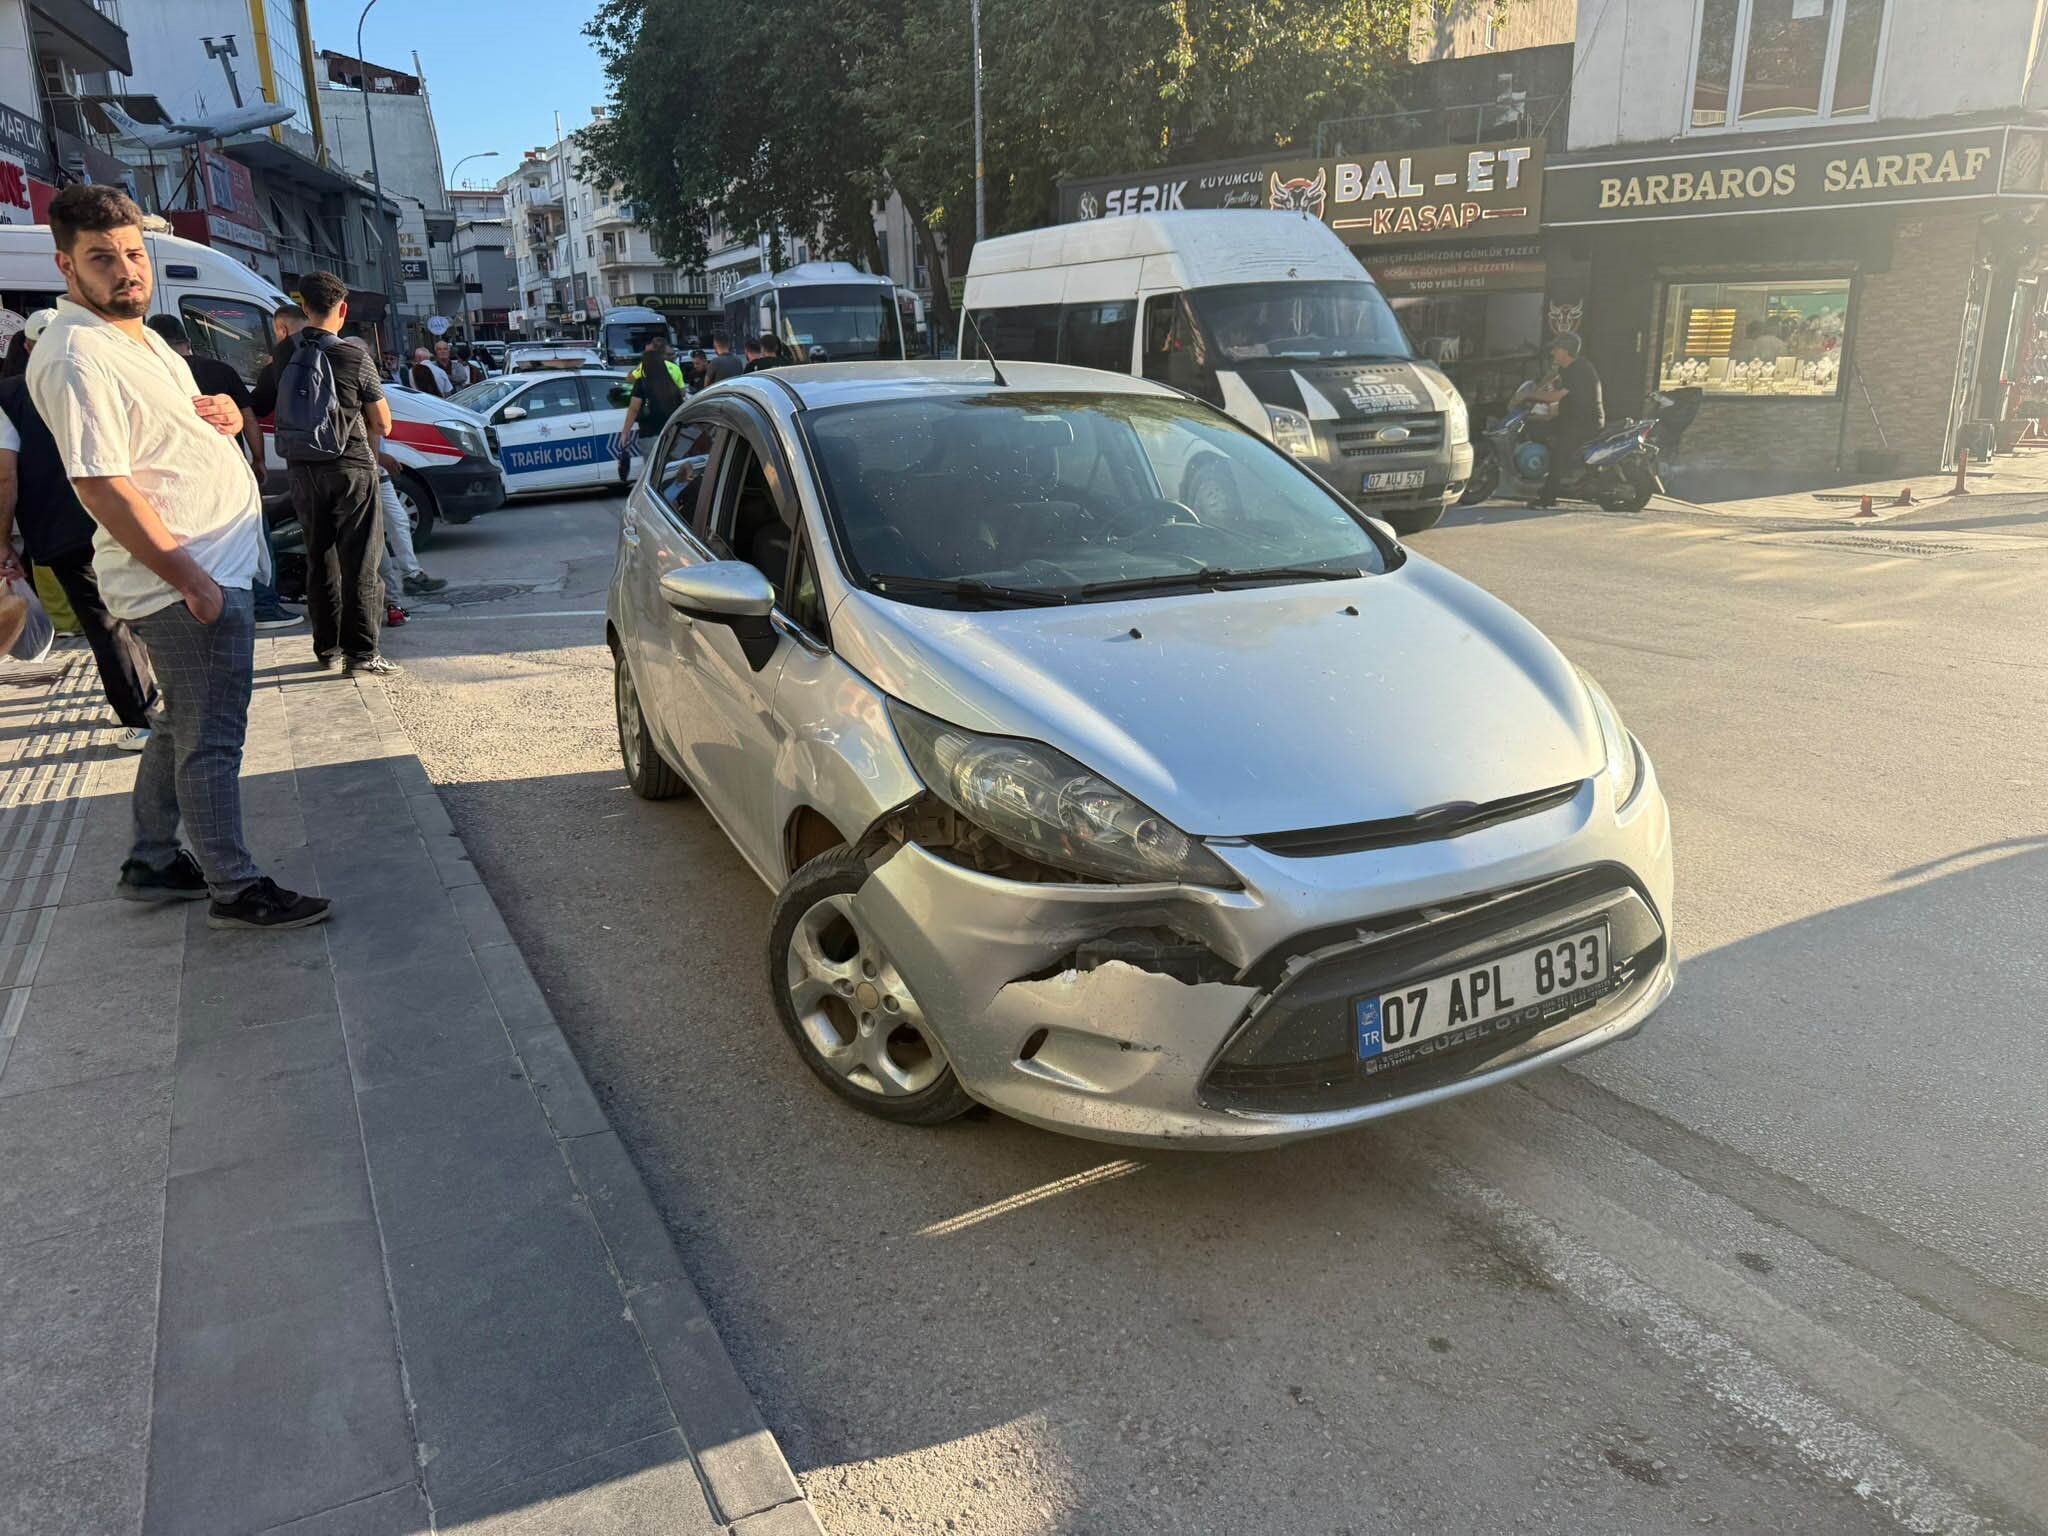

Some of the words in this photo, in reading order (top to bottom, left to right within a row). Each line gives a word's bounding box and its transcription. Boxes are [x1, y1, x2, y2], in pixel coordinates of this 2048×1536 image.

[1335, 157, 1424, 203] BAL
[1467, 147, 1531, 193] ET
[1599, 163, 1796, 209] BARBAROS
[1823, 146, 1991, 192] SARRAF
[1104, 181, 1189, 218] SERİK
[1373, 202, 1481, 235] KASAP
[1342, 383, 1412, 398] LİDER
[510, 446, 552, 468] TRAFİK
[555, 441, 592, 463] POLİSİ
[1369, 474, 1383, 488] 07
[1382, 987, 1428, 1044] 07
[1448, 963, 1514, 1027] APL
[1534, 934, 1600, 996] 833
[1496, 1006, 1540, 1030] OTO
[1362, 1030, 1379, 1046] TR
